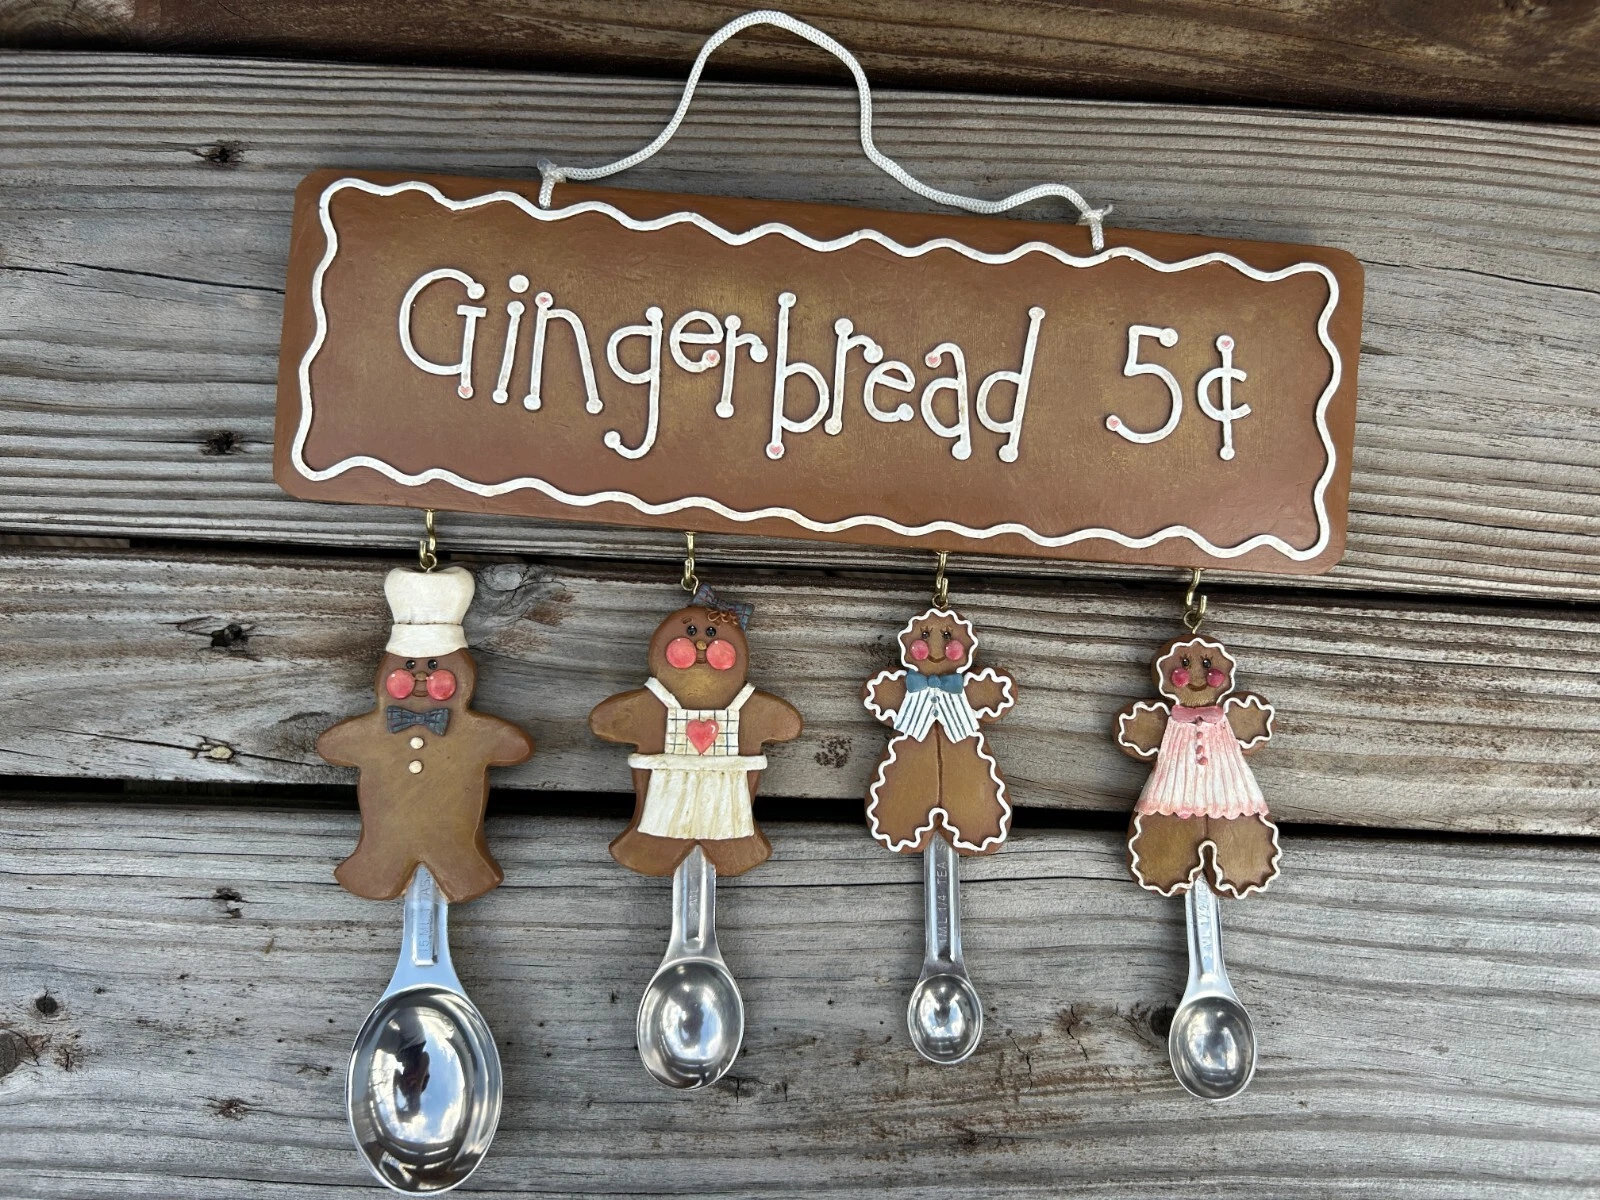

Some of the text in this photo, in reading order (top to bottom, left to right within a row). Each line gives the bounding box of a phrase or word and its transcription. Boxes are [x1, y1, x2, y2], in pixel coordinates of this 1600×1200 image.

[397, 267, 1254, 464] Gingerbread 5¢
[936, 895, 948, 912] 1/4
